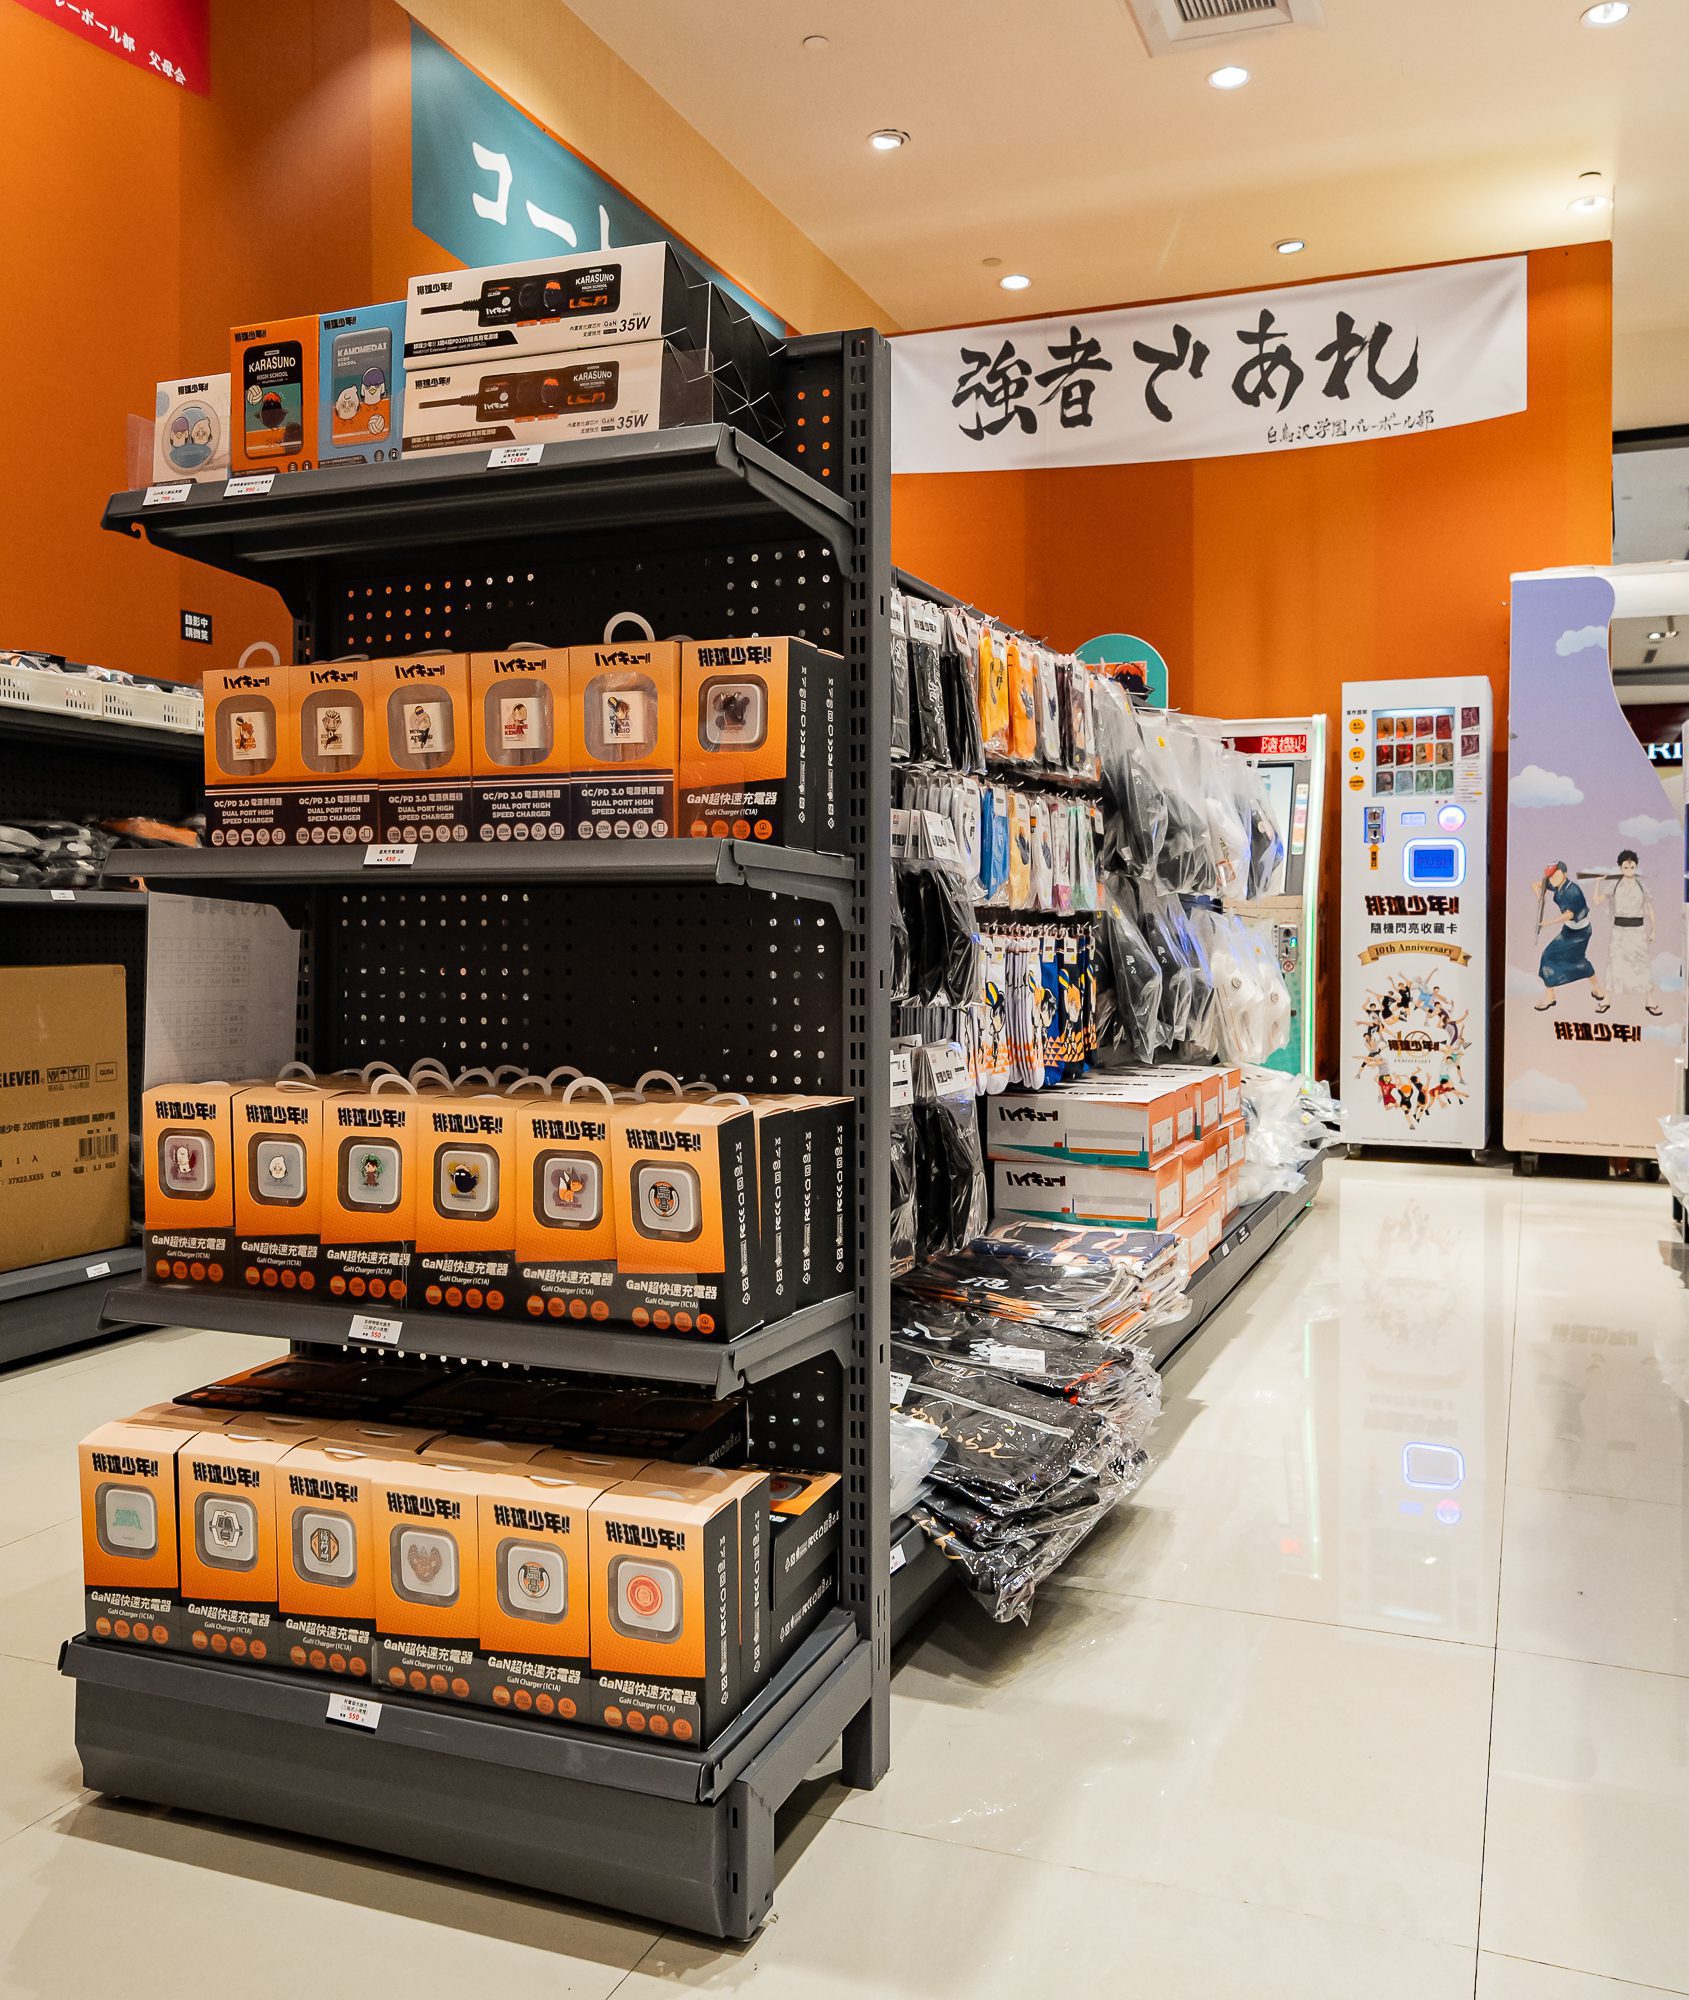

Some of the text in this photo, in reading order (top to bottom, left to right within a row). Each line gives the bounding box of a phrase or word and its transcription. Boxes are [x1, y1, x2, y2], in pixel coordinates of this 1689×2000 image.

[149, 50, 187, 86] 父母会
[575, 273, 615, 286] KARASUNO
[603, 320, 617, 328] GaN
[618, 315, 652, 333] 35W
[337, 342, 388, 358] KAMOMEDAI
[248, 356, 296, 373] KARASUNO
[256, 371, 289, 381] HIGH SCHOOL
[573, 370, 612, 382] KARASUNO
[951, 307, 1420, 441] 強者であれ
[616, 413, 649, 430] 35W
[1267, 409, 1434, 444] 白鳥沢学園バレーボール部
[697, 645, 772, 667] 排球少年!!
[388, 795, 414, 804] QC/PD
[415, 794, 427, 803] 3.0
[482, 792, 509, 801] QC/PD
[510, 791, 523, 800] 3.0
[581, 788, 610, 797] QC/PD
[611, 787, 625, 796] 3.0
[687, 791, 778, 806] GaN超快速充電器
[214, 799, 250, 808] QC/PD 3.0
[299, 796, 336, 805] QC/PD 3.0
[532, 801, 551, 809] HIGH
[591, 798, 654, 807] DUAL PORT HIGH
[257, 808, 274, 816] HIGH
[516, 810, 551, 818] CHARGER
[616, 807, 654, 815] CHARGER
[705, 808, 716, 816] GaN
[717, 808, 740, 817] Charger
[243, 816, 274, 824] CHARGER
[1364, 895, 1460, 916] 排球少年!!
[1370, 922, 1458, 934] 隨機閃亮收藏卡
[1374, 943, 1454, 956] 10th Anniversary
[1554, 1021, 1642, 1043] 排球少年!!
[155, 1100, 217, 1120] 排球少年!!
[245, 1104, 309, 1124] 排球少年!!
[337, 1107, 406, 1128] 排球少年!!
[432, 1112, 503, 1135] 排球少年!!
[531, 1118, 606, 1141] 排球少年!!
[625, 1128, 702, 1152] 排球少年!!
[151, 1235, 226, 1250] GaN超快速充電器
[241, 1241, 318, 1258] GaN超快速充電器
[176, 1251, 195, 1259] Charger
[267, 1258, 286, 1266] Charger
[327, 1249, 411, 1267] GaN超快速充電器
[355, 1266, 375, 1275] Charger
[422, 1258, 509, 1276] GaN超快速充電器
[451, 1276, 472, 1284] Charger
[522, 1268, 614, 1286] GaN超快速充電器
[554, 1286, 576, 1295] Charger
[626, 1279, 718, 1300] GaN超快速充電器
[645, 1296, 657, 1304] GaN
[658, 1297, 680, 1307] Charger
[91, 1452, 159, 1478] 排球少年!!
[192, 1460, 260, 1488] 排球少年!!
[289, 1474, 359, 1503] 排球少年!!
[386, 1491, 461, 1520] 排球少年!!
[493, 1503, 571, 1535] 排球少年!!
[605, 1520, 686, 1552] 排球少年!!
[91, 1591, 172, 1613] GaN超快速充電器
[107, 1607, 118, 1615] GaN
[118, 1609, 138, 1620] Charger
[187, 1603, 271, 1628] GaN超快速充電器
[204, 1621, 215, 1629] GaN
[215, 1622, 236, 1633] Charger
[285, 1618, 370, 1645] GaN超快速充電器
[302, 1636, 314, 1644] GaN
[314, 1638, 335, 1650] Charger
[383, 1639, 474, 1665] GaN超快速充電器
[401, 1657, 413, 1665] GaN
[414, 1659, 436, 1671] Charger
[487, 1656, 581, 1685] GaN超快速充電器
[506, 1675, 519, 1684] GaN
[519, 1677, 543, 1690] Charger
[599, 1676, 697, 1706] GaN超快速充電器
[618, 1696, 631, 1705] GaN
[632, 1698, 657, 1710] Charger
